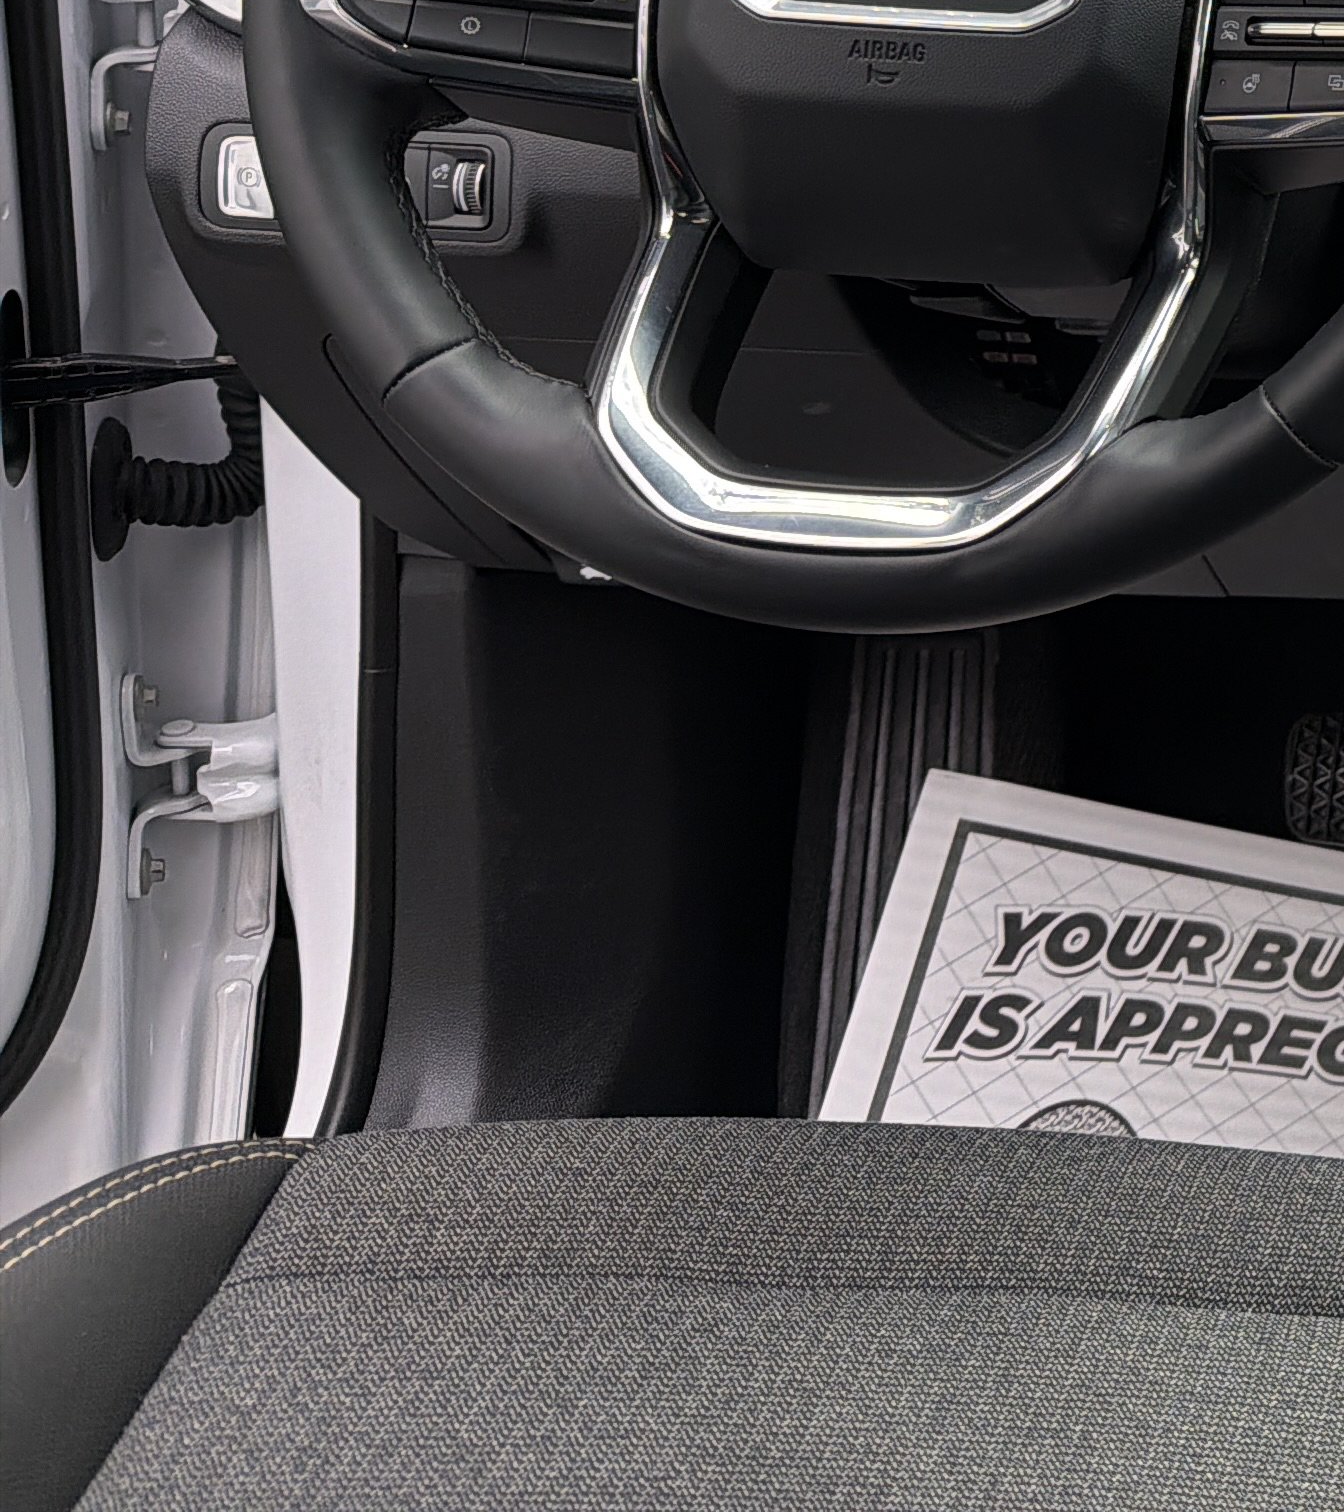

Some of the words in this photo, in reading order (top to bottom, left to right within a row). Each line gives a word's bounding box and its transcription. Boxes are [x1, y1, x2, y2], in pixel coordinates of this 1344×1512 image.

[849, 39, 927, 63] AIRBAG
[992, 910, 1231, 977] YOUR
[933, 993, 1036, 1053] IS
